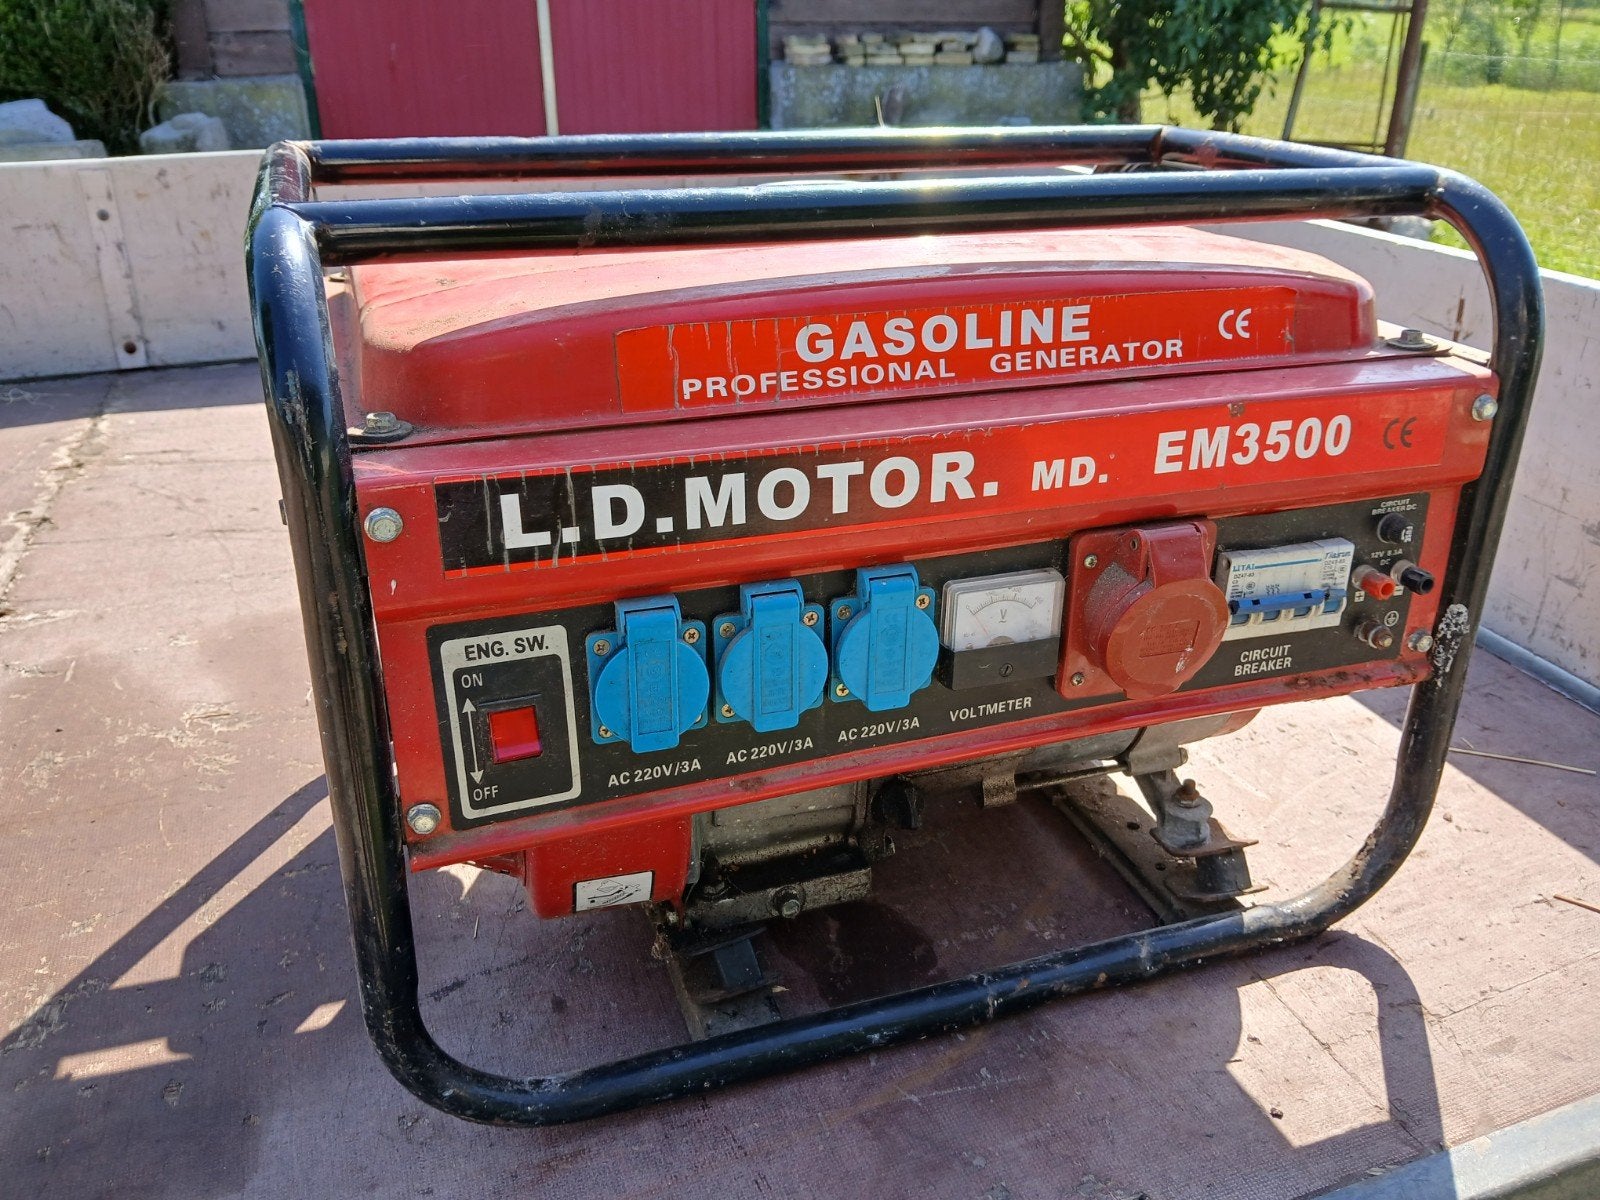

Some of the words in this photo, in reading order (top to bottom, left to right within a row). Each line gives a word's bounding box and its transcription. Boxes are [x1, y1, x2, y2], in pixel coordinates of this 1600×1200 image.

[795, 305, 1091, 364] GASOLINE
[1218, 308, 1252, 340] CE
[682, 358, 955, 399] PROFESSIONAL
[990, 339, 1184, 373] GENERATOR
[1382, 416, 1415, 450] CE
[1032, 455, 1109, 491] MD.
[1154, 414, 1351, 475] EM3500
[1381, 498, 1410, 507] CIRCUIT
[1406, 503, 1417, 511] DC
[464, 640, 509, 661] ENG.
[514, 634, 549, 654] SW.
[1240, 644, 1292, 663] CIRCUIT
[1234, 656, 1292, 677] BREAKER
[461, 672, 484, 689] ON
[950, 696, 1033, 722] VOLTMETER
[837, 727, 858, 743] AC
[860, 716, 920, 739] 220V/3A
[726, 750, 748, 765] AC
[750, 736, 814, 760] 220V/3A
[607, 771, 631, 787] AC
[634, 758, 702, 783] 220V/3A
[473, 784, 499, 802] OFF
